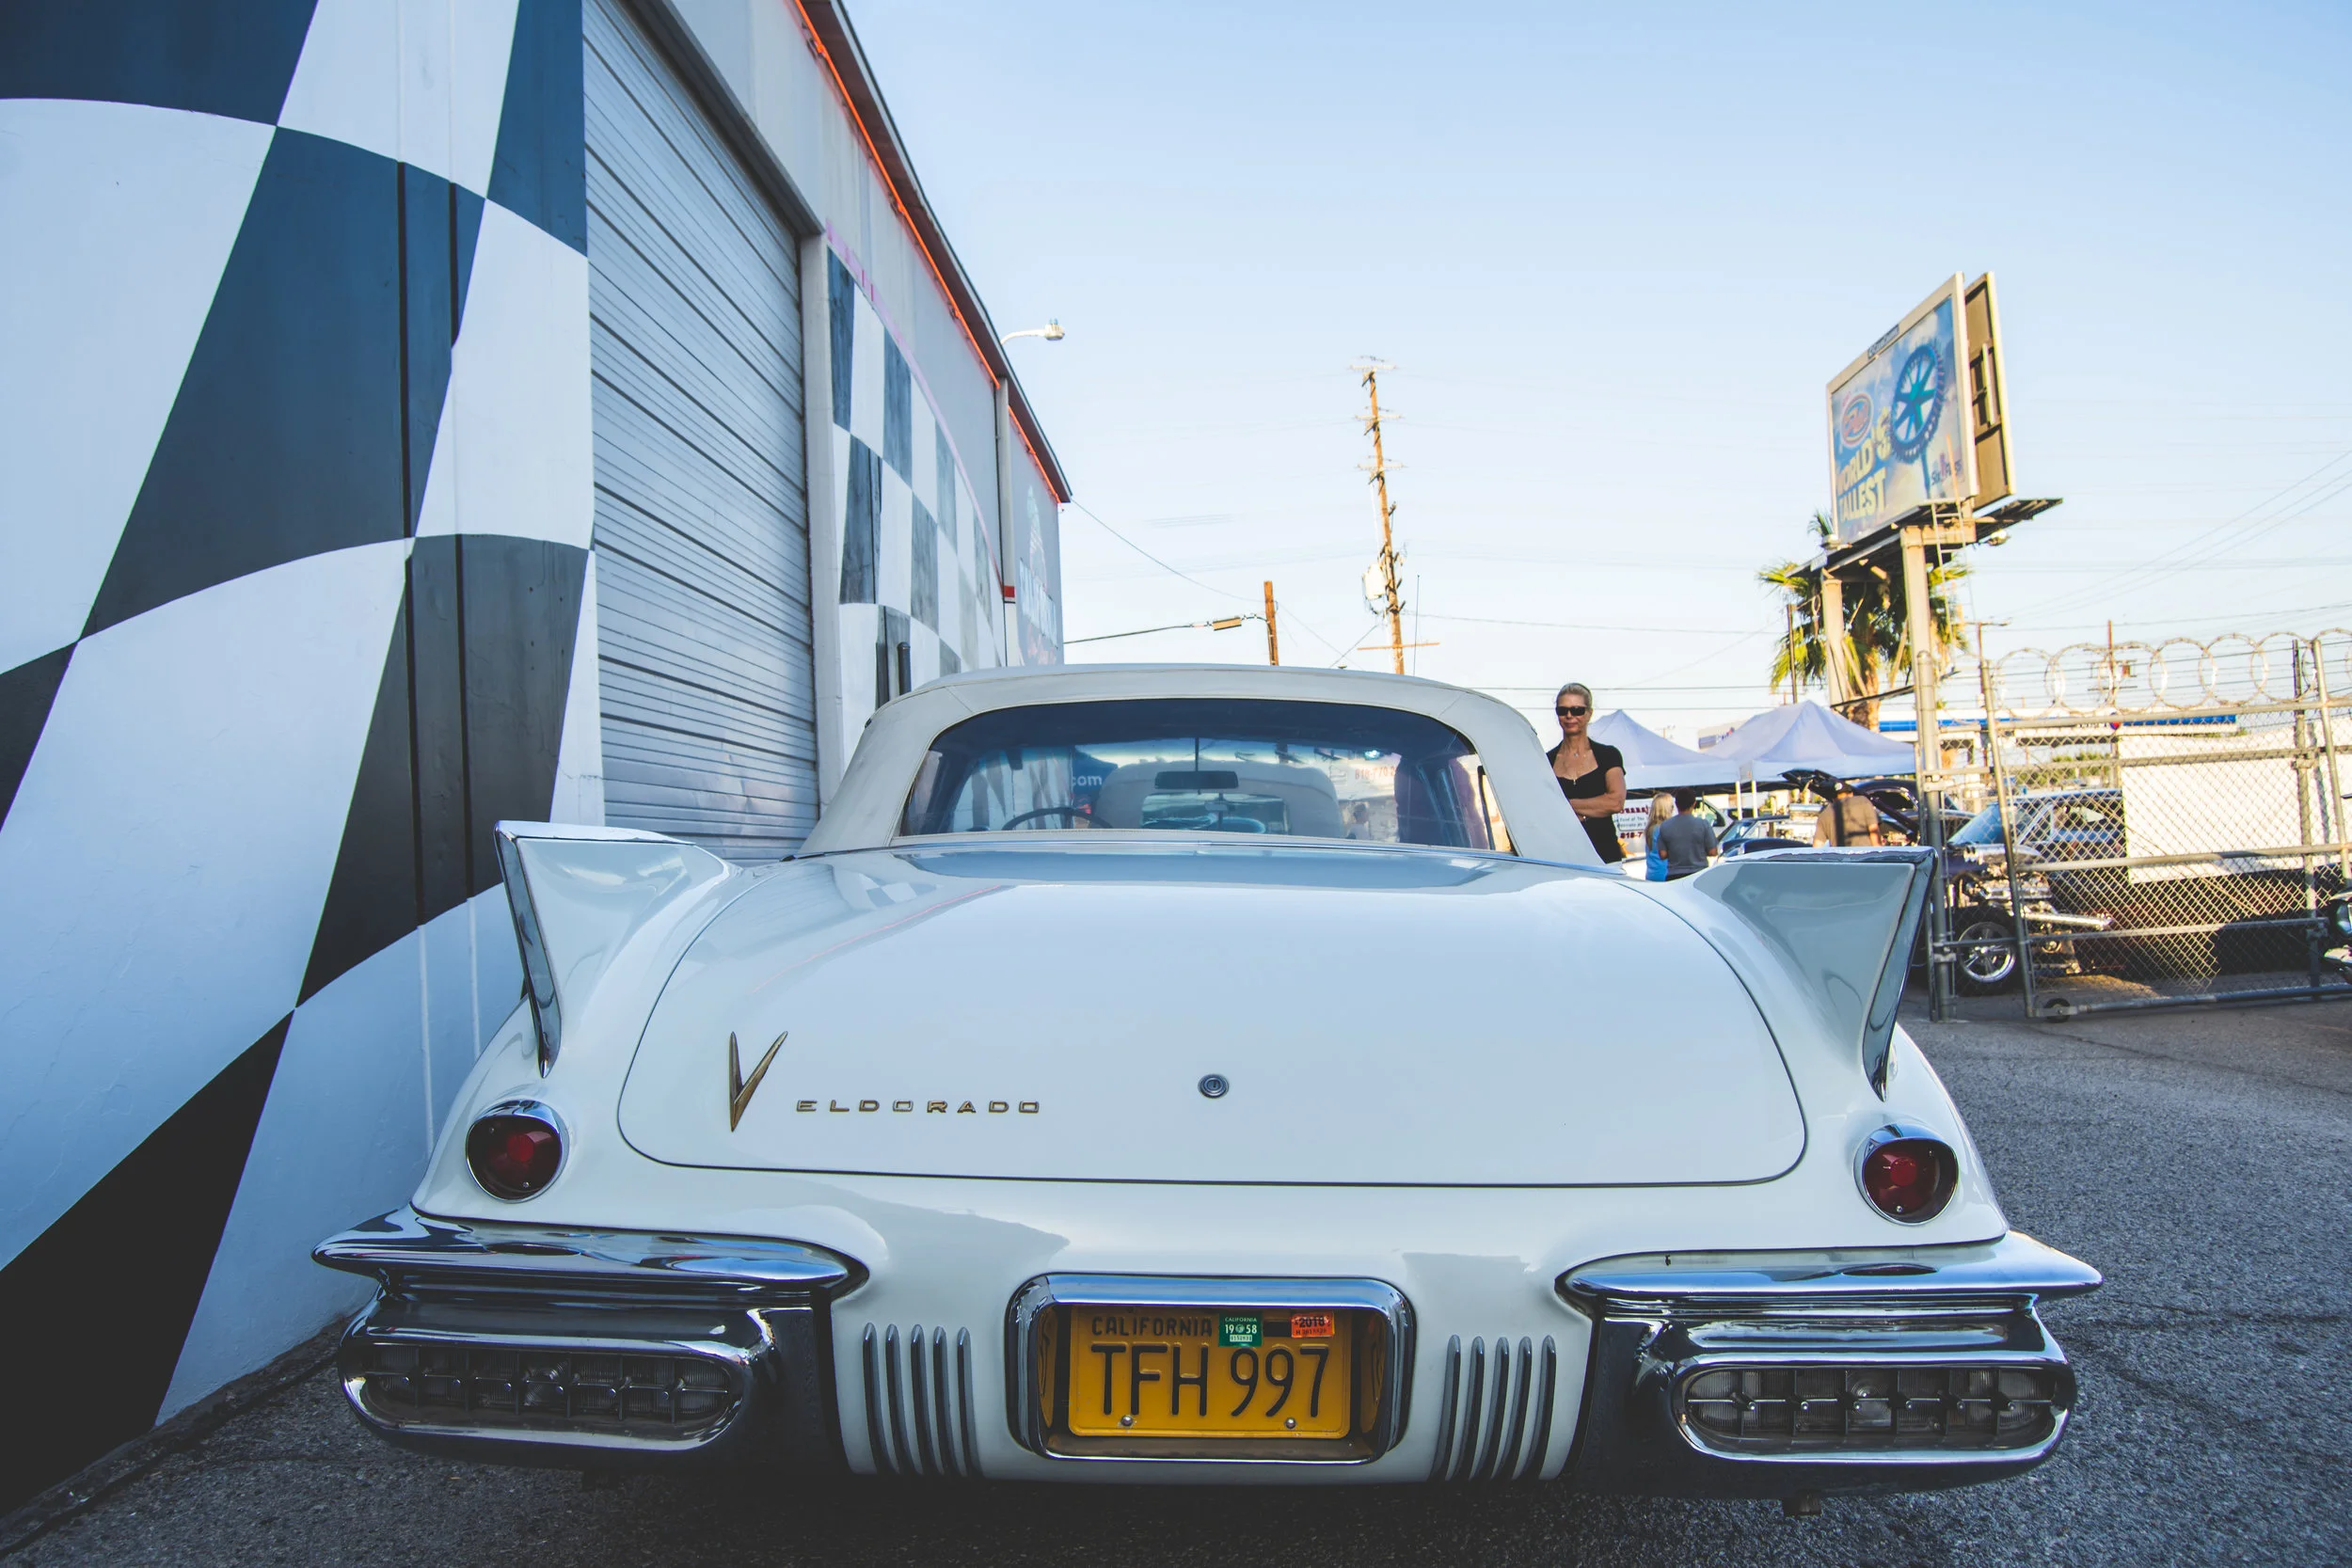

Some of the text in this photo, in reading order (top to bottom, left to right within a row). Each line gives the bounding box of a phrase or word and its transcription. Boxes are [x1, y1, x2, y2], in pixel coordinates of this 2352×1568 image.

[1836, 406, 1891, 496] WORLD'S
[1839, 467, 1887, 522] TALLEST
[796, 1100, 1041, 1114] ELDORADO
[1091, 1317, 1213, 1337] CALIFORNIA
[1090, 1343, 1330, 1417] TFH 997
